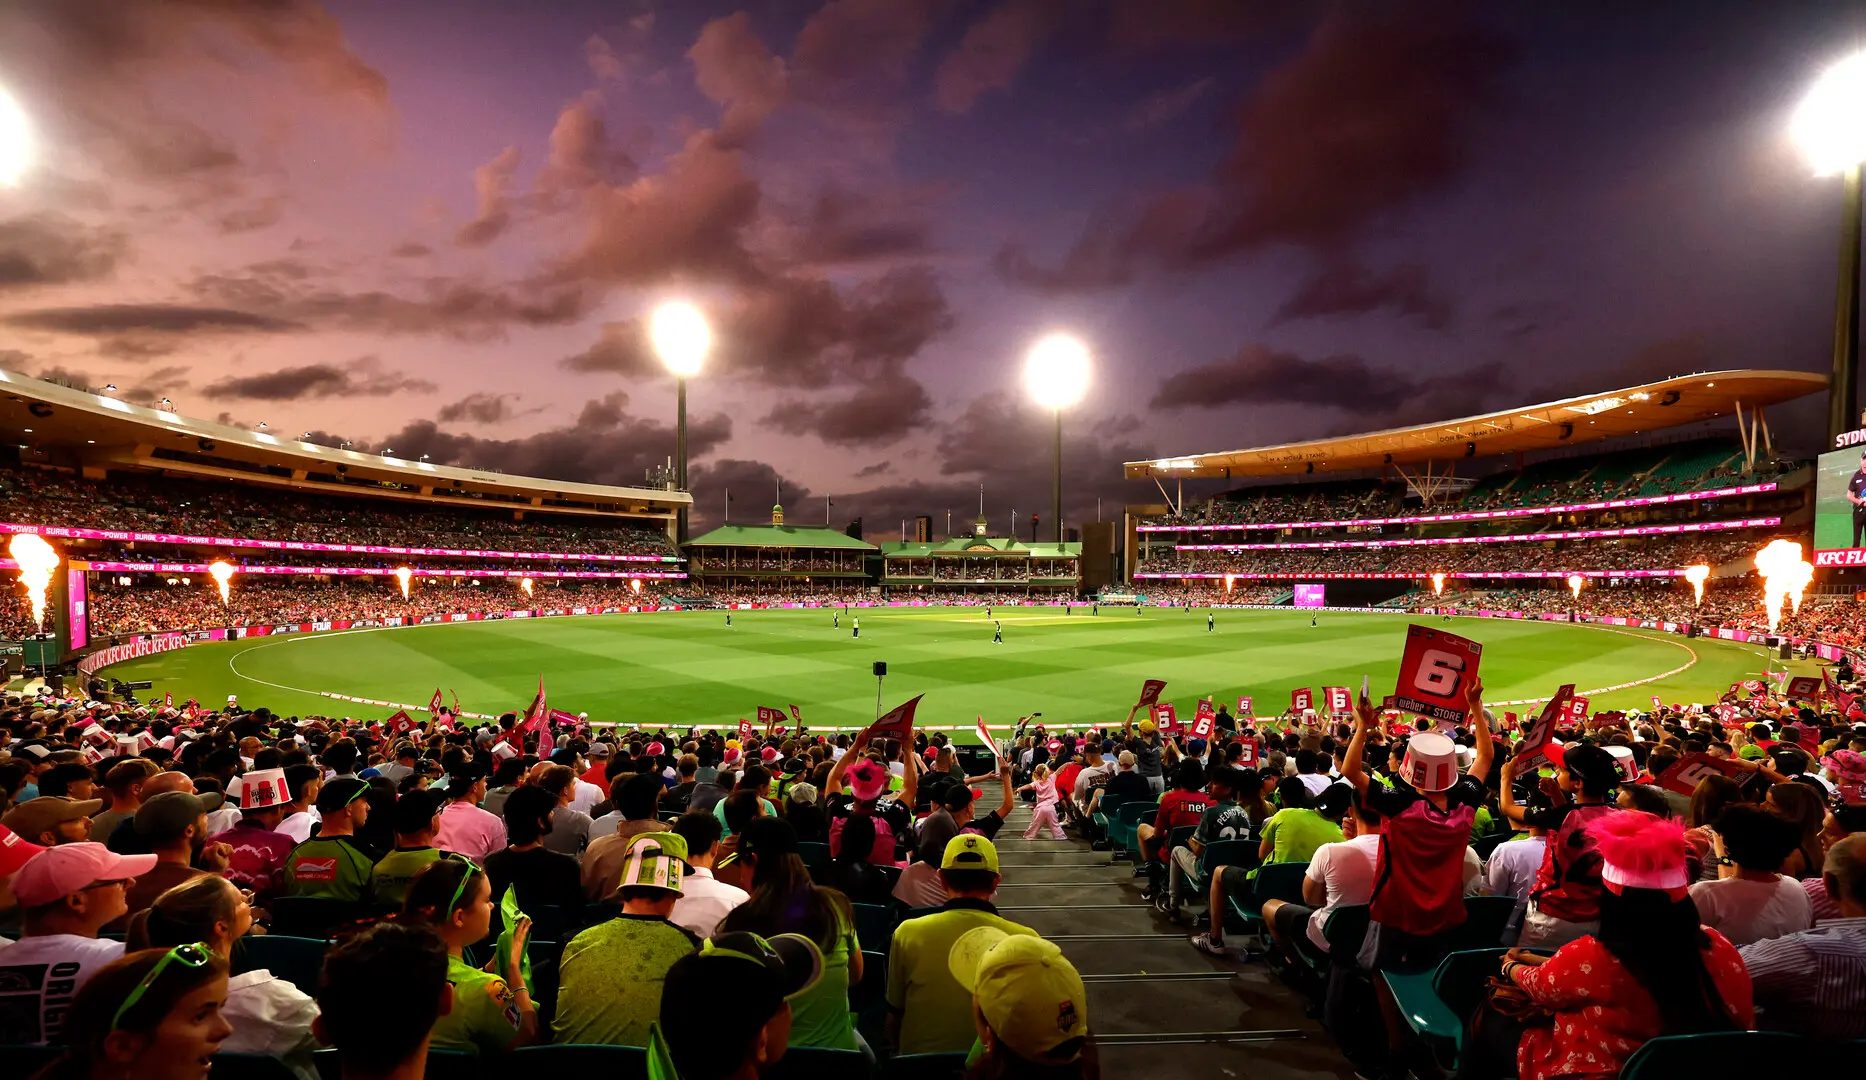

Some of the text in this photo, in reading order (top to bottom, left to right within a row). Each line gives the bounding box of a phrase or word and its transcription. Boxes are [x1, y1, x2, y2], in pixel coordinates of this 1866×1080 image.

[46, 528, 70, 536] SURGE
[1816, 552, 1844, 565] KFC
[312, 622, 331, 631] FOUR
[385, 618, 402, 626] FOUR
[108, 646, 120, 665] KFC
[120, 643, 136, 661] KFC
[136, 640, 151, 657] KFC
[152, 637, 168, 654] KFC
[168, 635, 185, 650] KFC
[1414, 649, 1466, 698] 6
[167, 696, 172, 705] 6
[1241, 700, 1250, 710] 6
[1296, 694, 1307, 709] 6
[1332, 694, 1346, 708] 6
[1399, 698, 1461, 722] weber STORE
[1573, 702, 1584, 714] 6
[1158, 711, 1170, 729] 6
[1195, 717, 1211, 735] 6
[741, 724, 748, 732] 6
